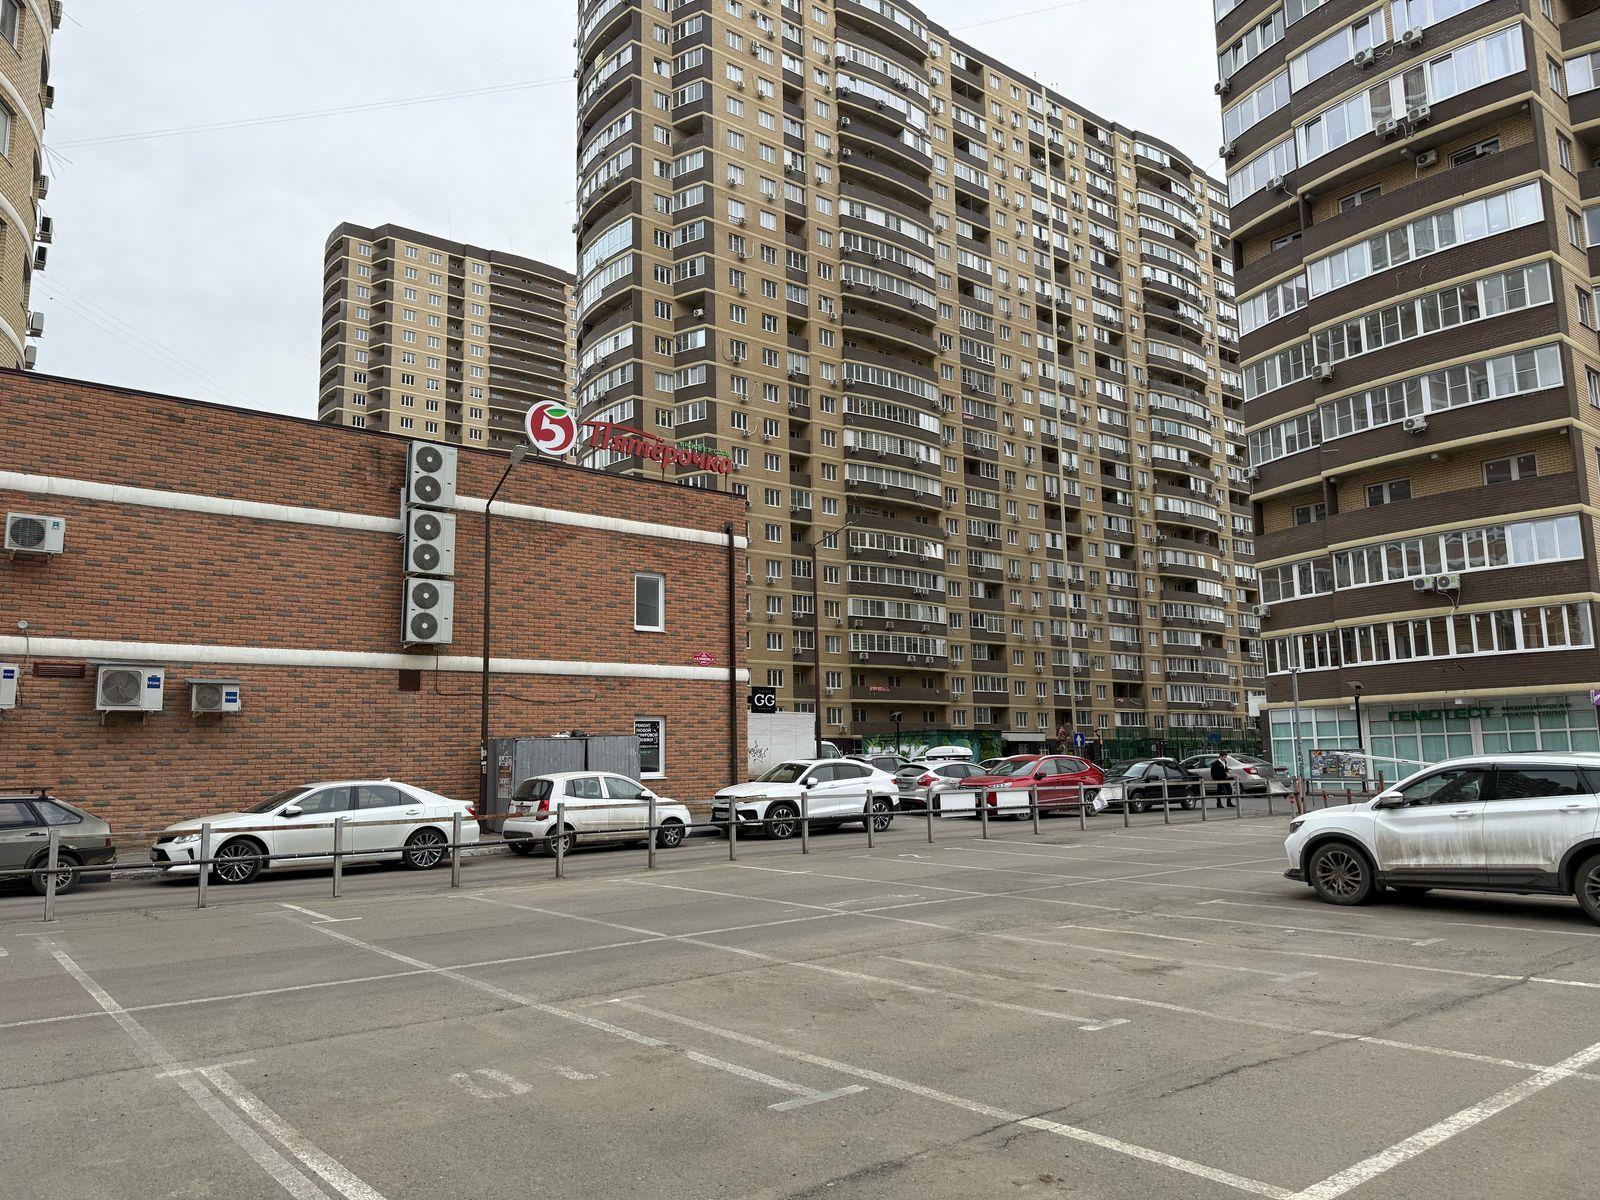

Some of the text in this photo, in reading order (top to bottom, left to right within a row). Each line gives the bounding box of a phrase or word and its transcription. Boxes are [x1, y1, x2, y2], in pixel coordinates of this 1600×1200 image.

[578, 419, 733, 474] Пятёрочка
[754, 693, 776, 707] GG
[1388, 706, 1495, 721] ГЕМОТЕСТ
